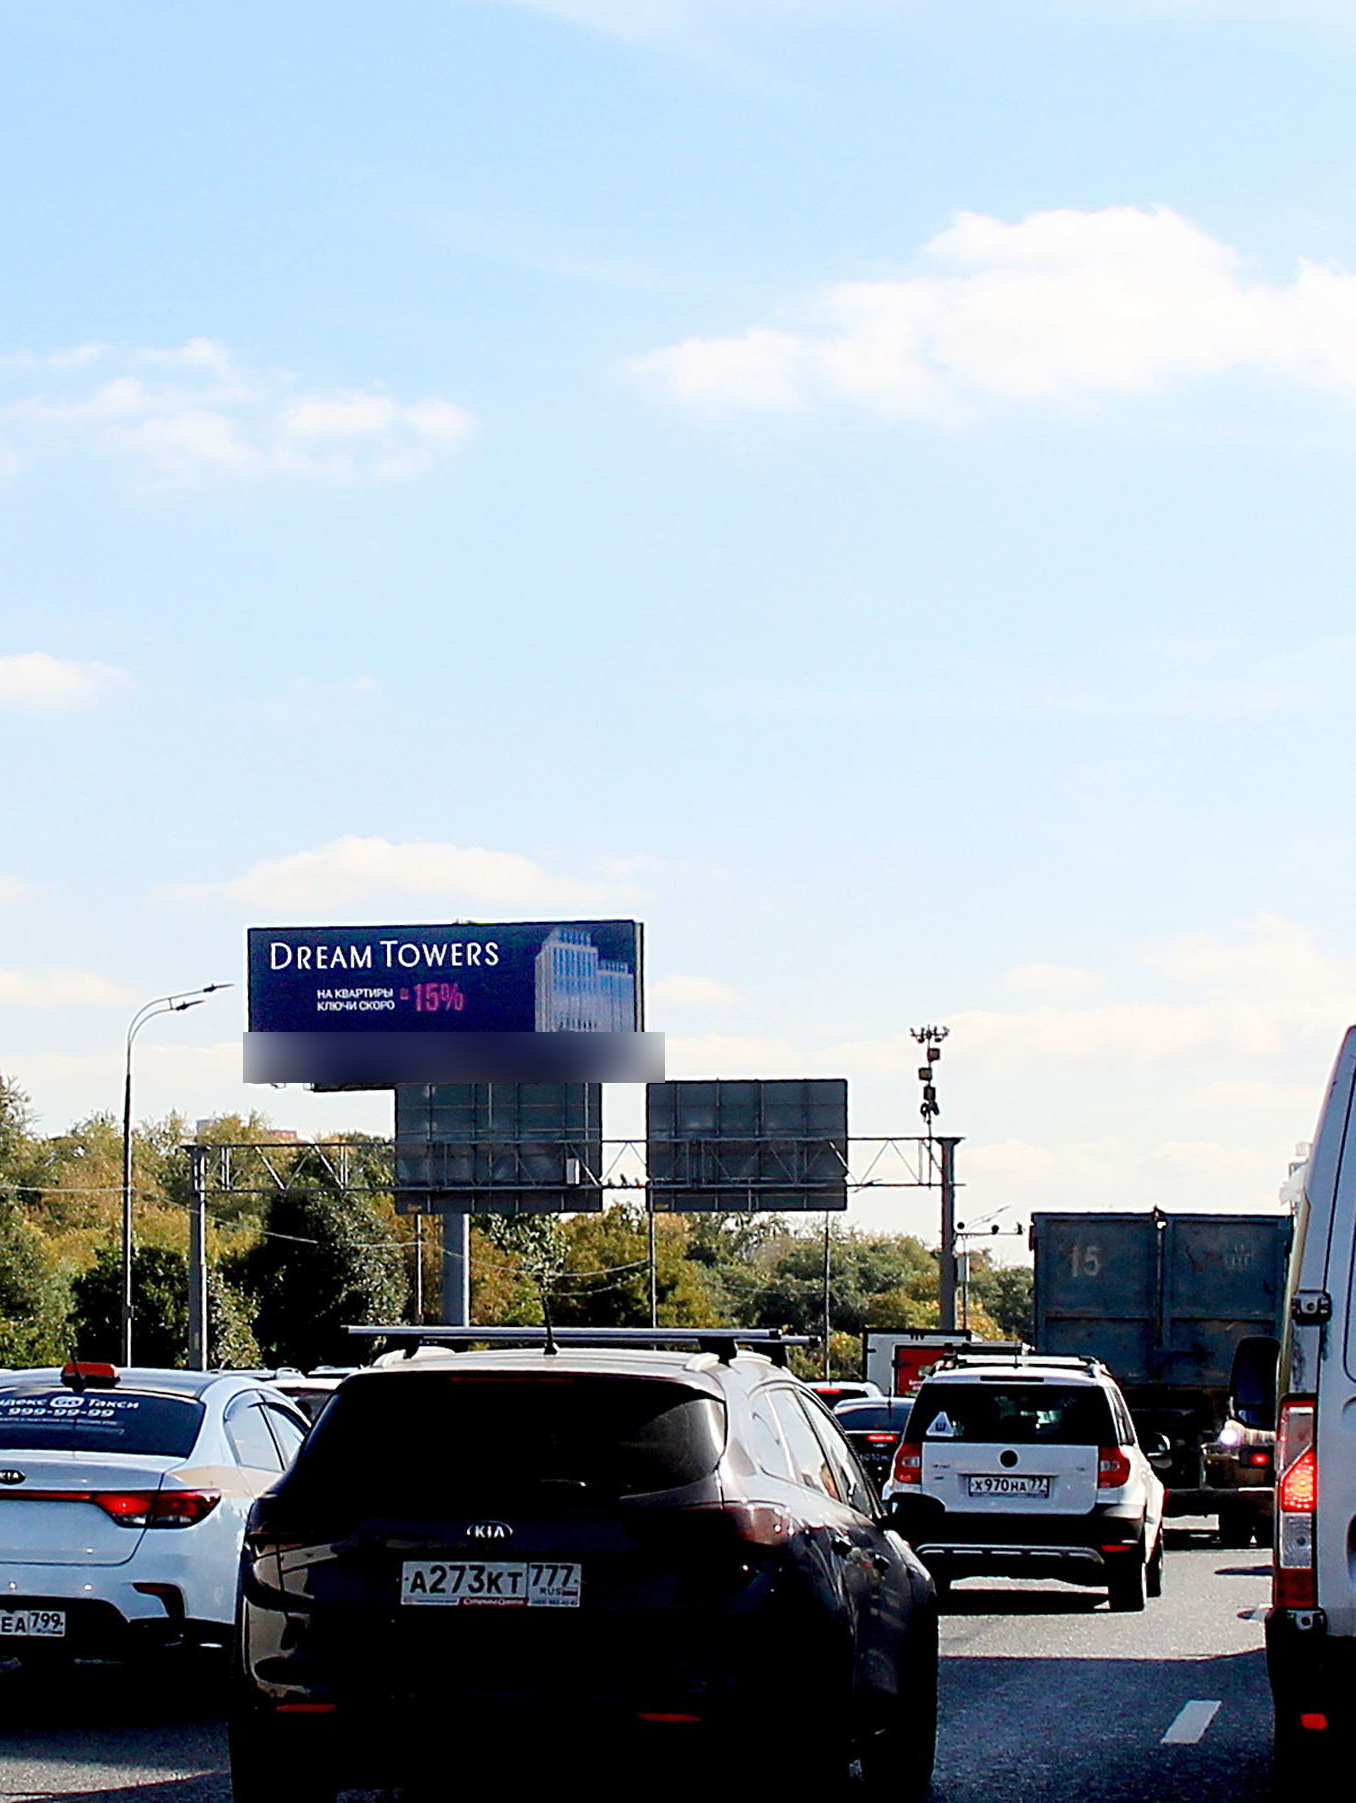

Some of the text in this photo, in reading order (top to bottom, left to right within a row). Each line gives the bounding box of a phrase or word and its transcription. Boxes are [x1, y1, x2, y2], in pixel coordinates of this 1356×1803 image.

[270, 940, 499, 970] DREAM TOWERS
[317, 989, 333, 999] НА
[334, 988, 394, 999] КВАРТИРЫ
[317, 1000, 395, 1011] КЛЮЧИ СКОРО
[87, 1399, 139, 1409] Такси
[0, 1472, 20, 1480] KIA
[475, 1525, 505, 1539] KIA
[531, 1564, 574, 1588] 777
[30, 1612, 61, 1630] 799
